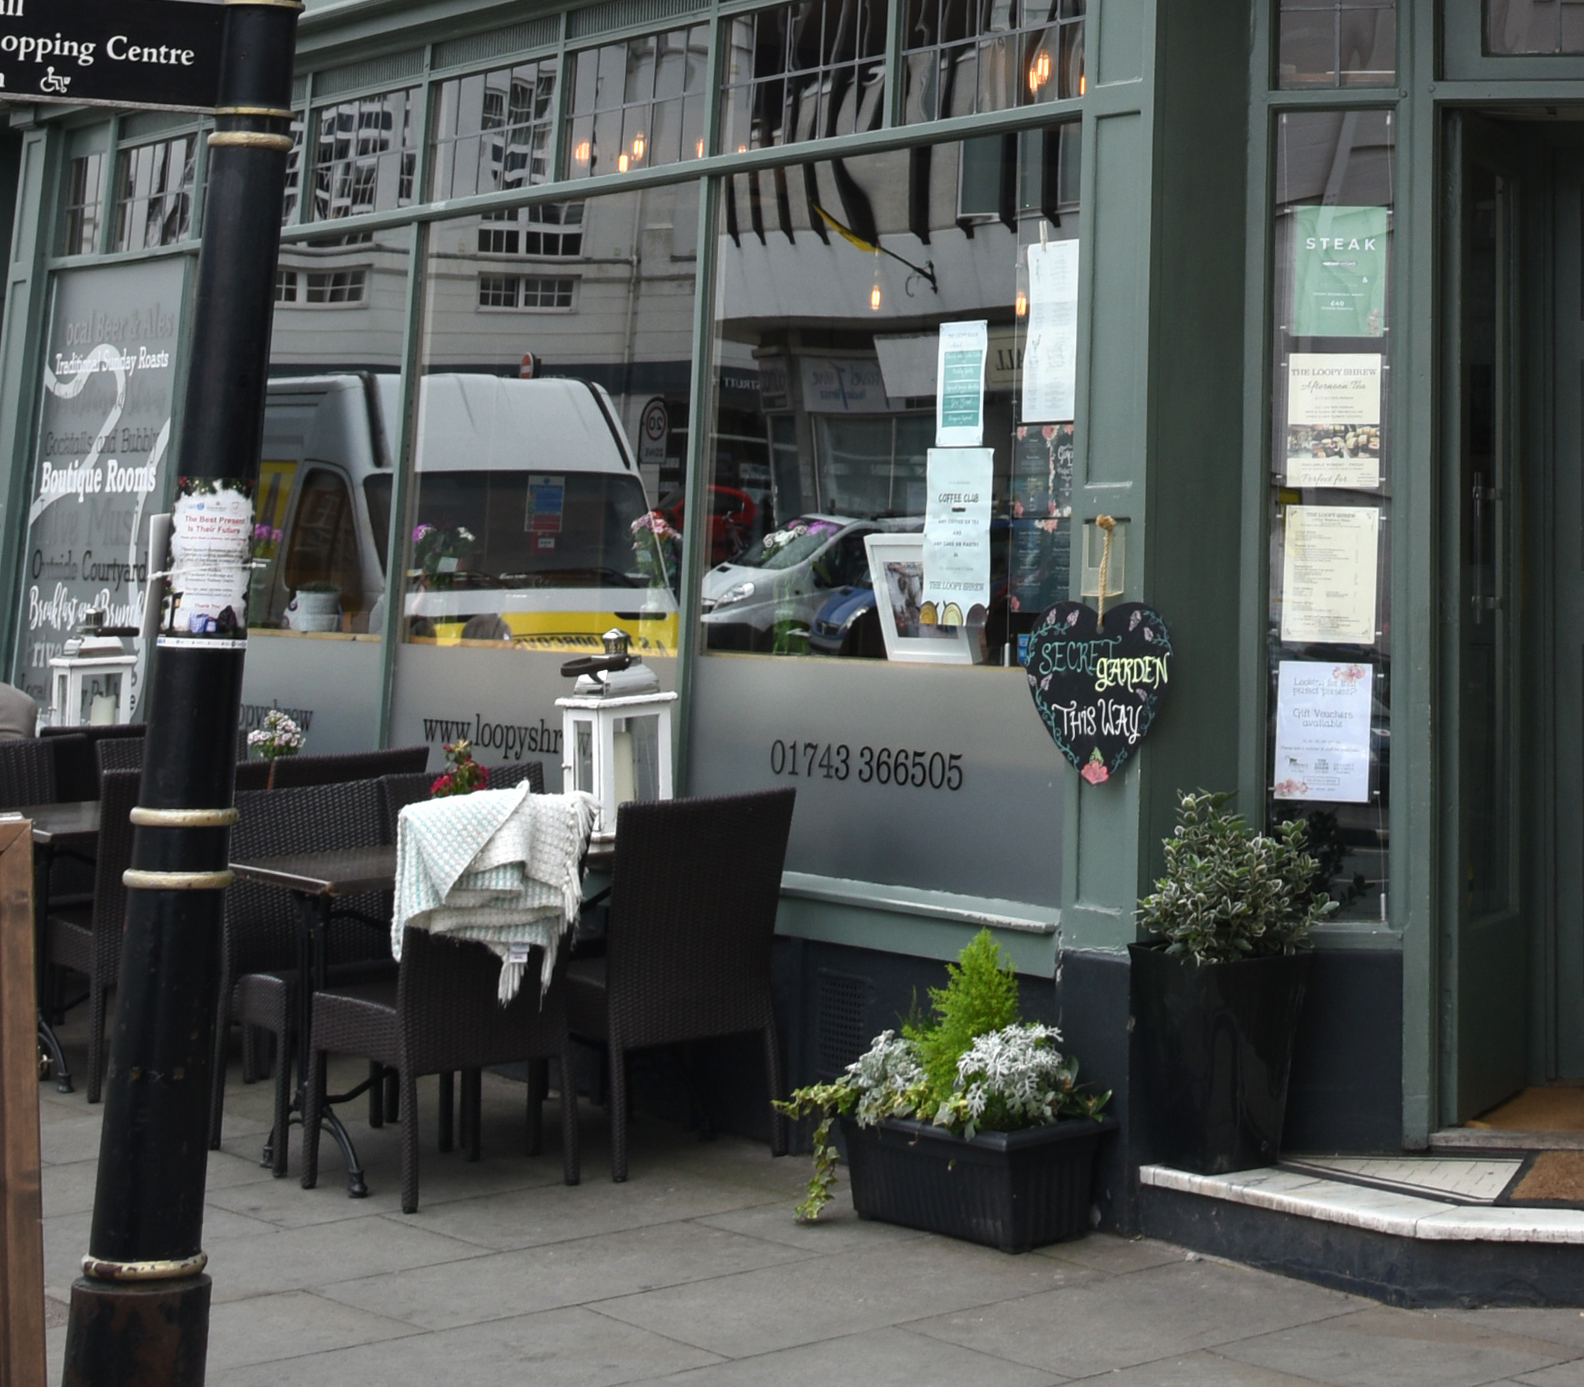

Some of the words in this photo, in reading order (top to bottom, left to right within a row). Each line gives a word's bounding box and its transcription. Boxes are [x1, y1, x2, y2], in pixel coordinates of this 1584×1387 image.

[106, 35, 195, 66] Centre
[1306, 237, 1376, 250] STEAK
[55, 351, 100, 375] Traditional
[101, 348, 137, 376] Sunday
[138, 346, 169, 369] Roasts
[1291, 368, 1310, 376] THE
[1312, 368, 1342, 376] LOOPY
[1343, 368, 1377, 376] SHREW
[1301, 381, 1348, 393] Afternoon
[1351, 381, 1366, 390] Tea
[45, 431, 92, 456] Cocktails
[96, 428, 116, 454] and
[121, 427, 159, 463] Bubbly
[40, 460, 102, 502] Boutique
[104, 459, 157, 493] Rooms
[938, 493, 962, 503] COFFEE
[963, 493, 979, 503] CLUB
[185, 515, 197, 523] The
[199, 516, 217, 524] Best
[219, 516, 245, 525] Present
[196, 525, 216, 533] Their
[217, 526, 241, 534] Future
[82, 550, 147, 591] Courtyard
[929, 581, 941, 590] THE
[942, 581, 962, 590] LOOPY
[963, 582, 984, 591] SHREW
[29, 582, 79, 631] Breakfast
[1039, 635, 1122, 676] SECRET
[1095, 652, 1170, 693] GARDEN
[1294, 678, 1325, 688] Looking
[1327, 678, 1339, 686] for
[1293, 708, 1310, 718] Gift
[1314, 709, 1353, 719] Vouchers
[1051, 701, 1096, 741] THIS
[1097, 698, 1143, 744] WAY
[1303, 719, 1342, 728] available
[770, 740, 851, 782] 01743
[858, 746, 963, 790] 366505
